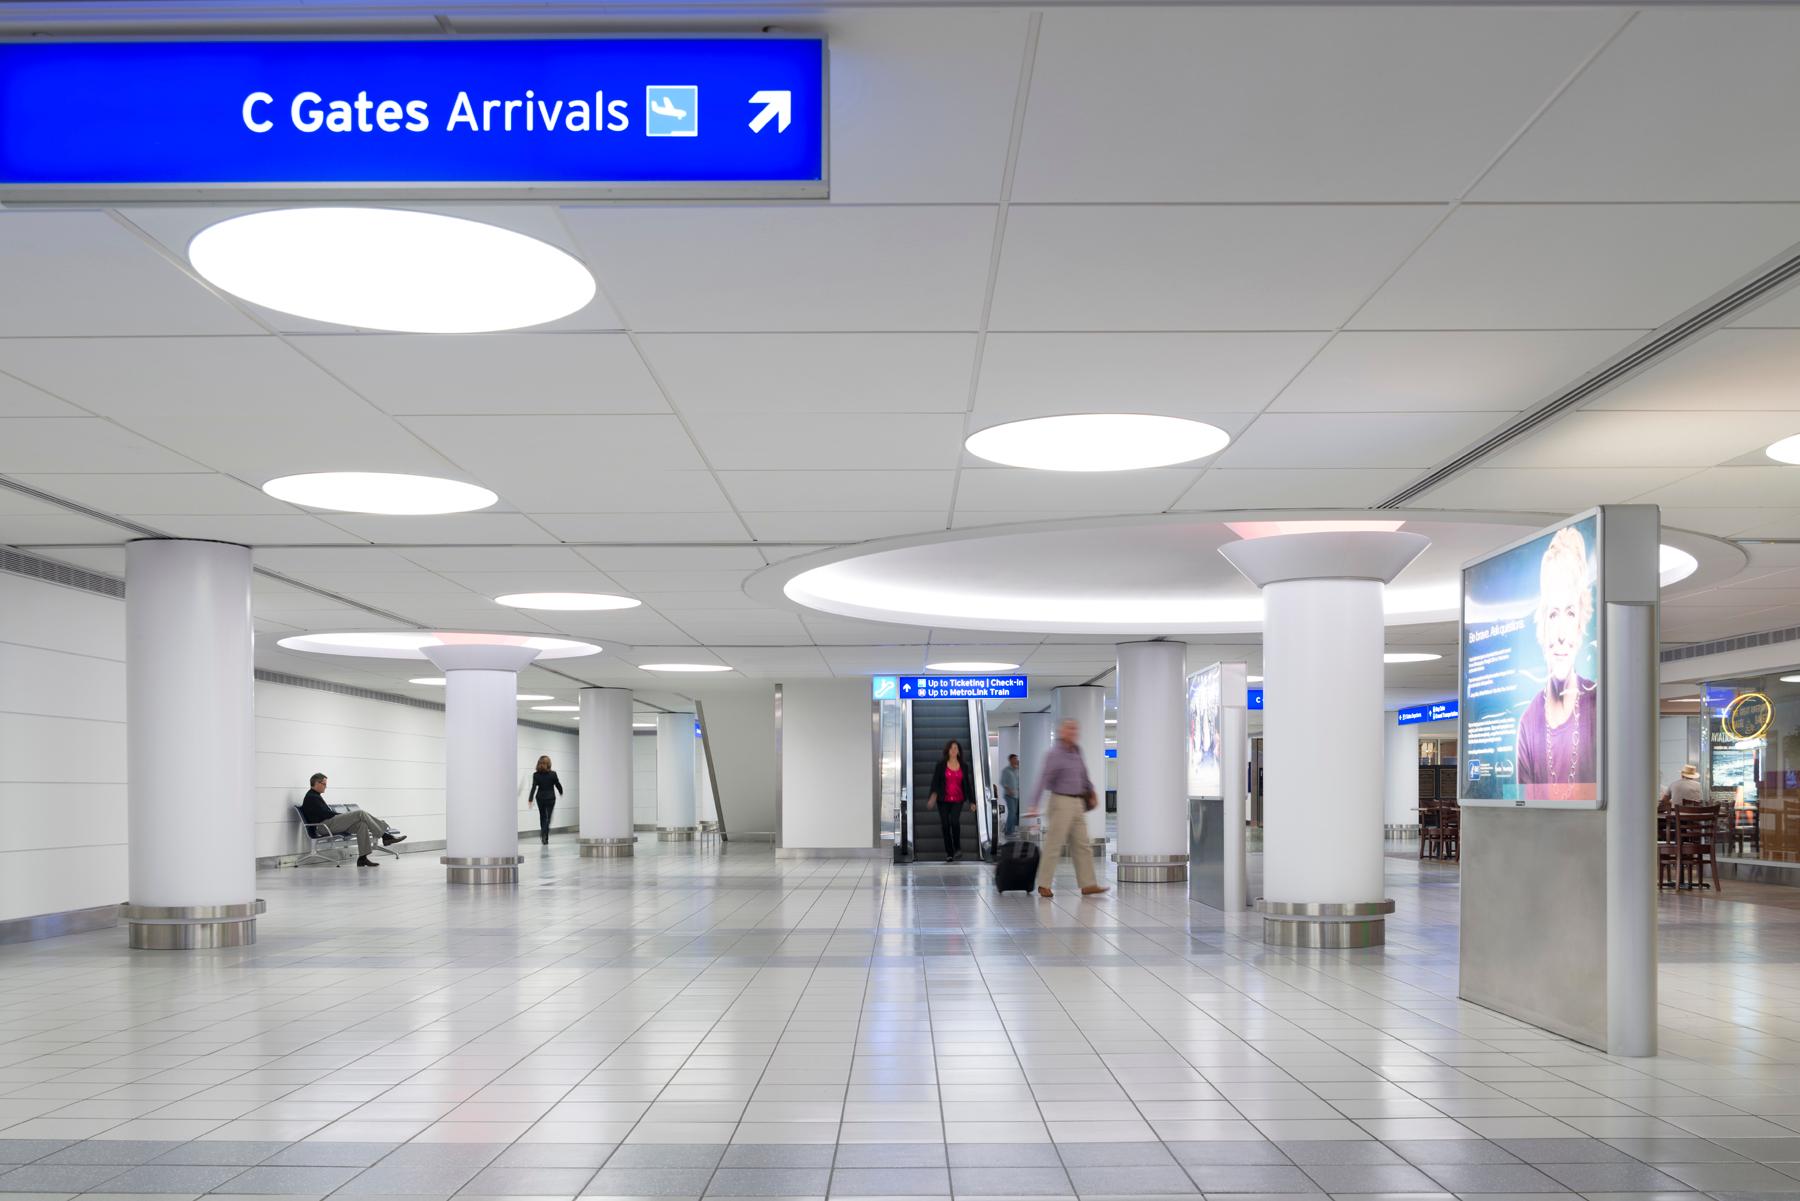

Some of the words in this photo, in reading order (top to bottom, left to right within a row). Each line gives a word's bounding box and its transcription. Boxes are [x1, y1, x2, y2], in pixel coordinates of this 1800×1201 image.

[243, 92, 273, 132] C
[291, 91, 429, 132] Gates
[447, 90, 628, 131] Arrivals
[928, 679, 938, 688] Up
[950, 679, 985, 688] Ticketing
[928, 689, 938, 697] Up
